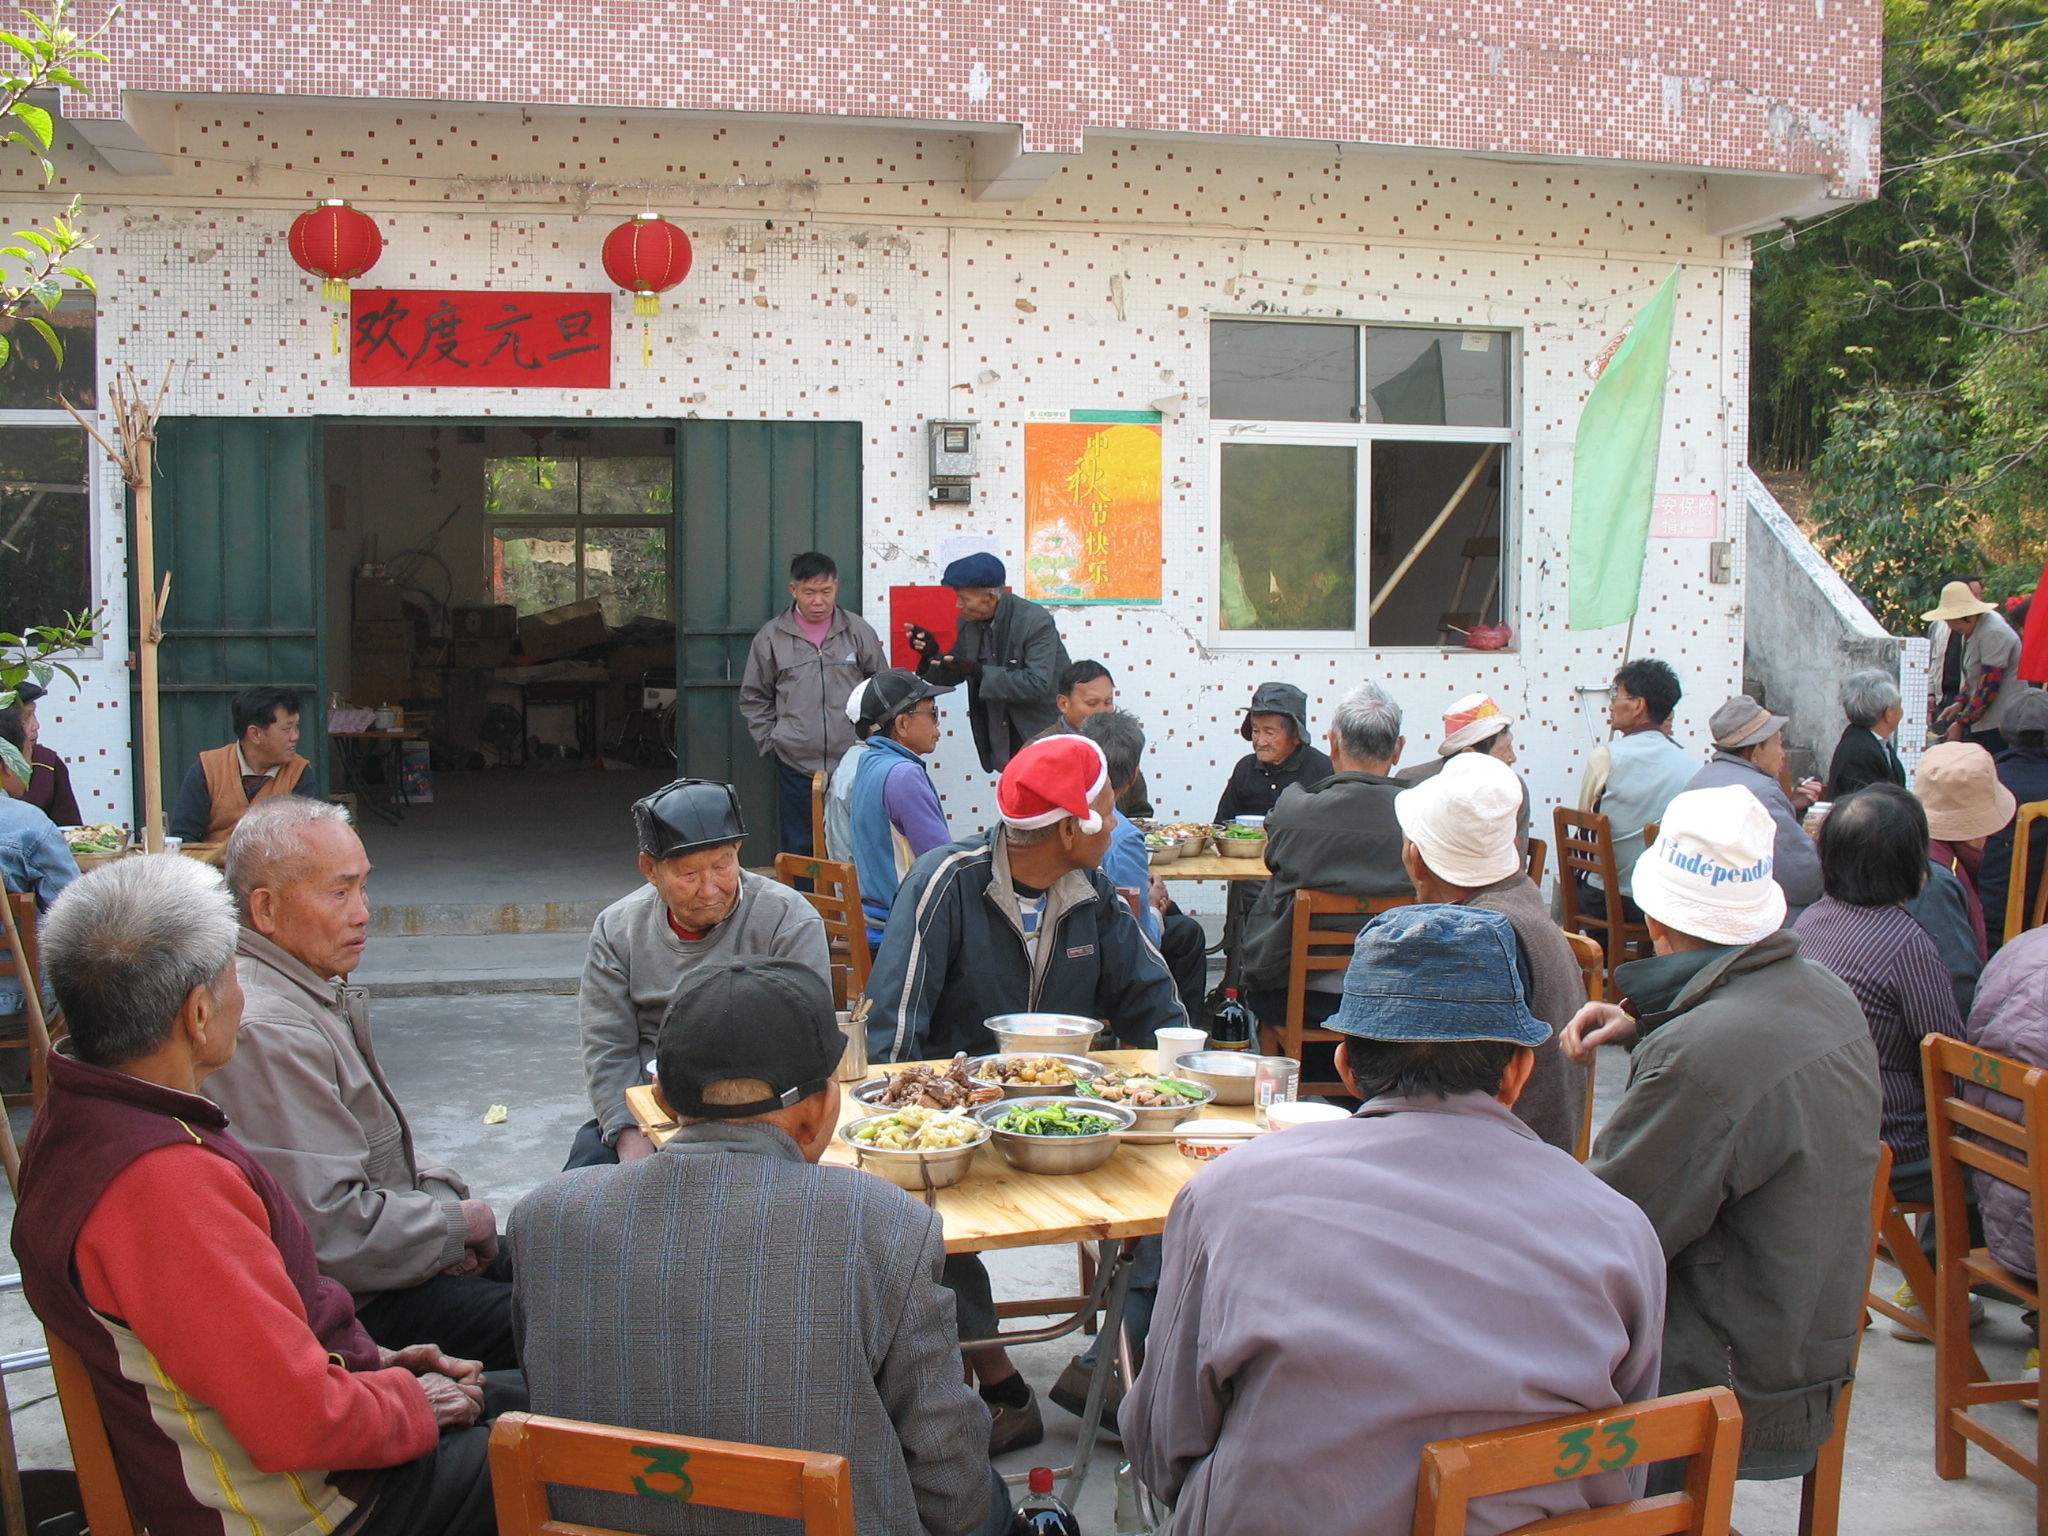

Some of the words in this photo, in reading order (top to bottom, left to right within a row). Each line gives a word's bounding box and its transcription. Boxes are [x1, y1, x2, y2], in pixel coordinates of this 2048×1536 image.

[355, 297, 600, 370] 欢度元旦
[1064, 431, 1113, 584] 中秋节快乐
[1653, 496, 1714, 516] 安保险
[1972, 1052, 2002, 1089] 23
[631, 1445, 694, 1502] 3
[1553, 1418, 1639, 1477] 33
